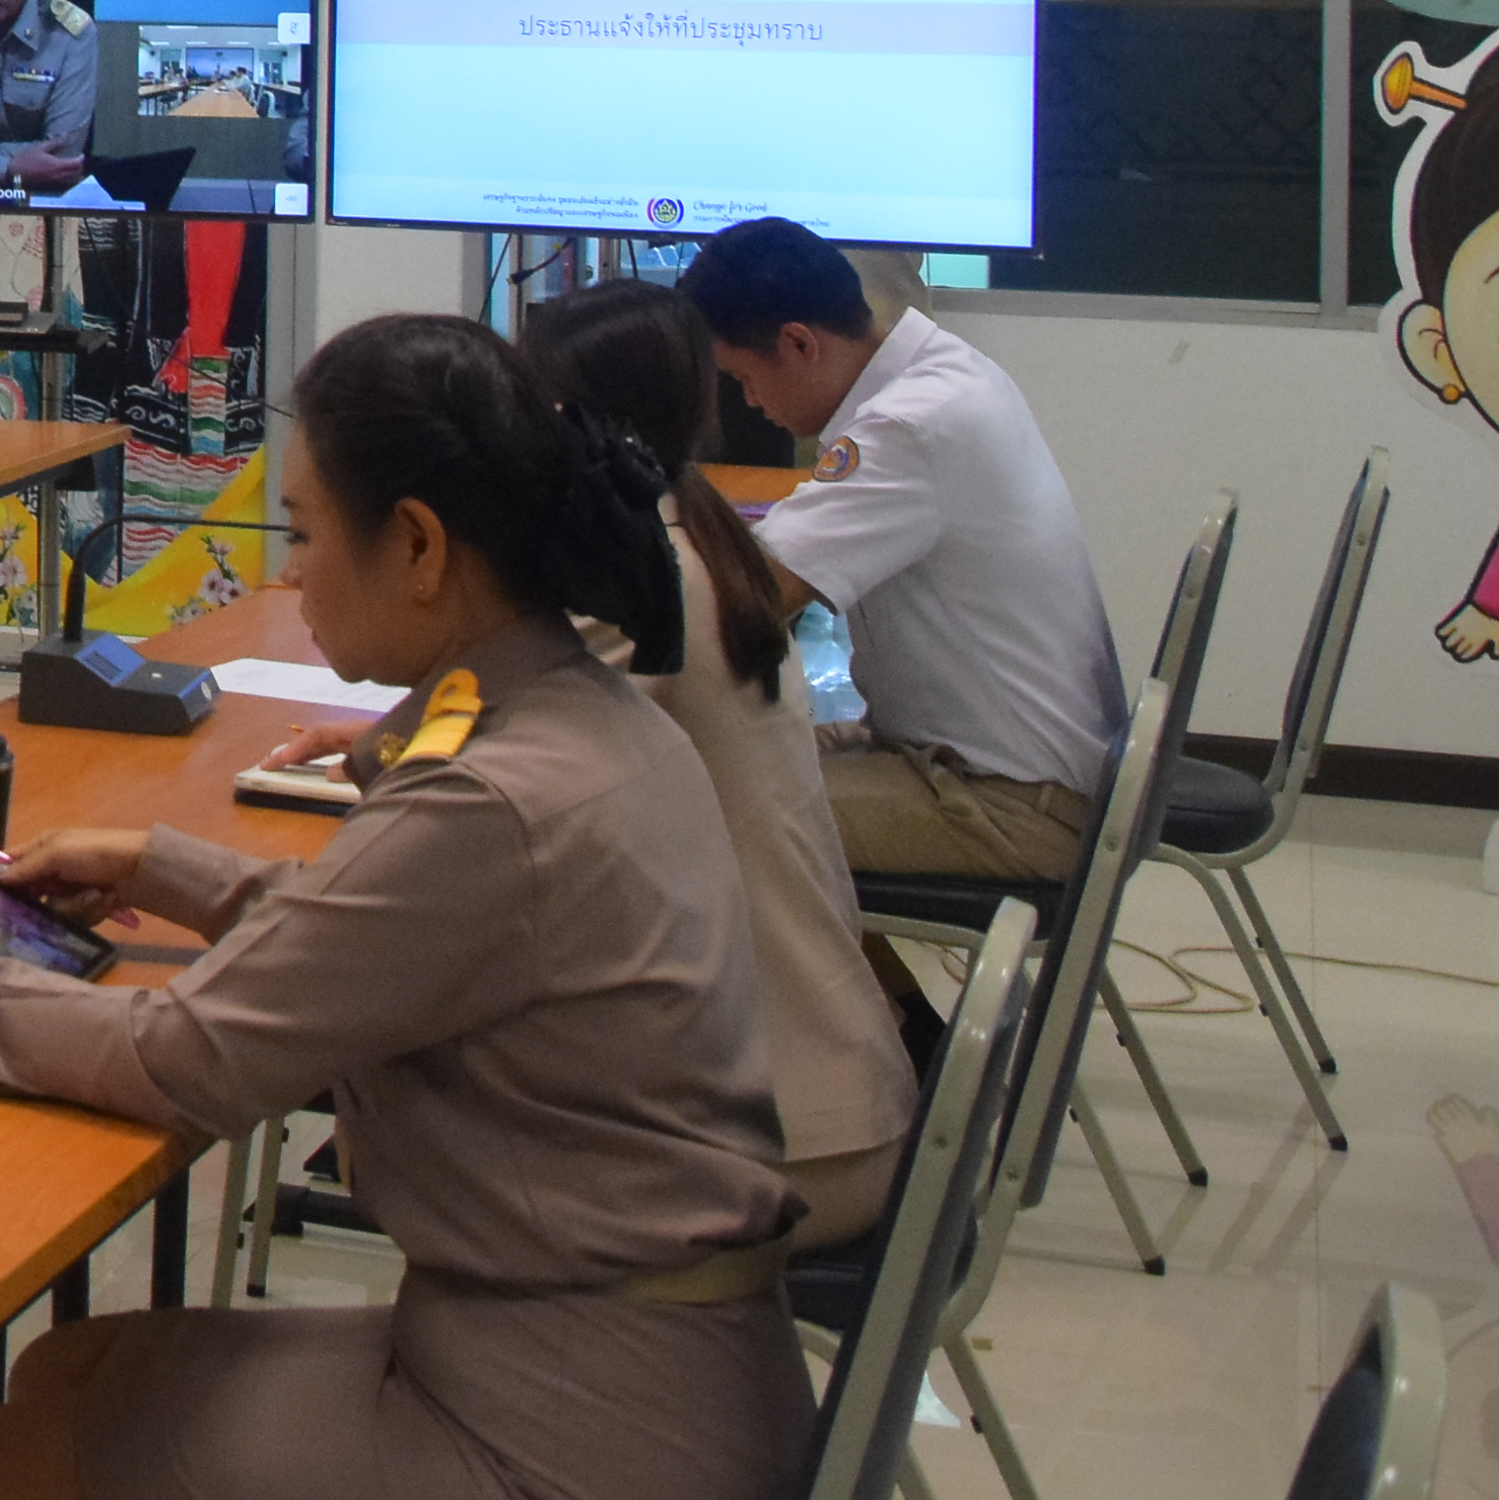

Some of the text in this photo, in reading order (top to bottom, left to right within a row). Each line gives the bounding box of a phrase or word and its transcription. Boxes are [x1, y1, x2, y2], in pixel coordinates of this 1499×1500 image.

[519, 10, 823, 48] ประธานแจ้งให้ที่ประชุมทราบ
